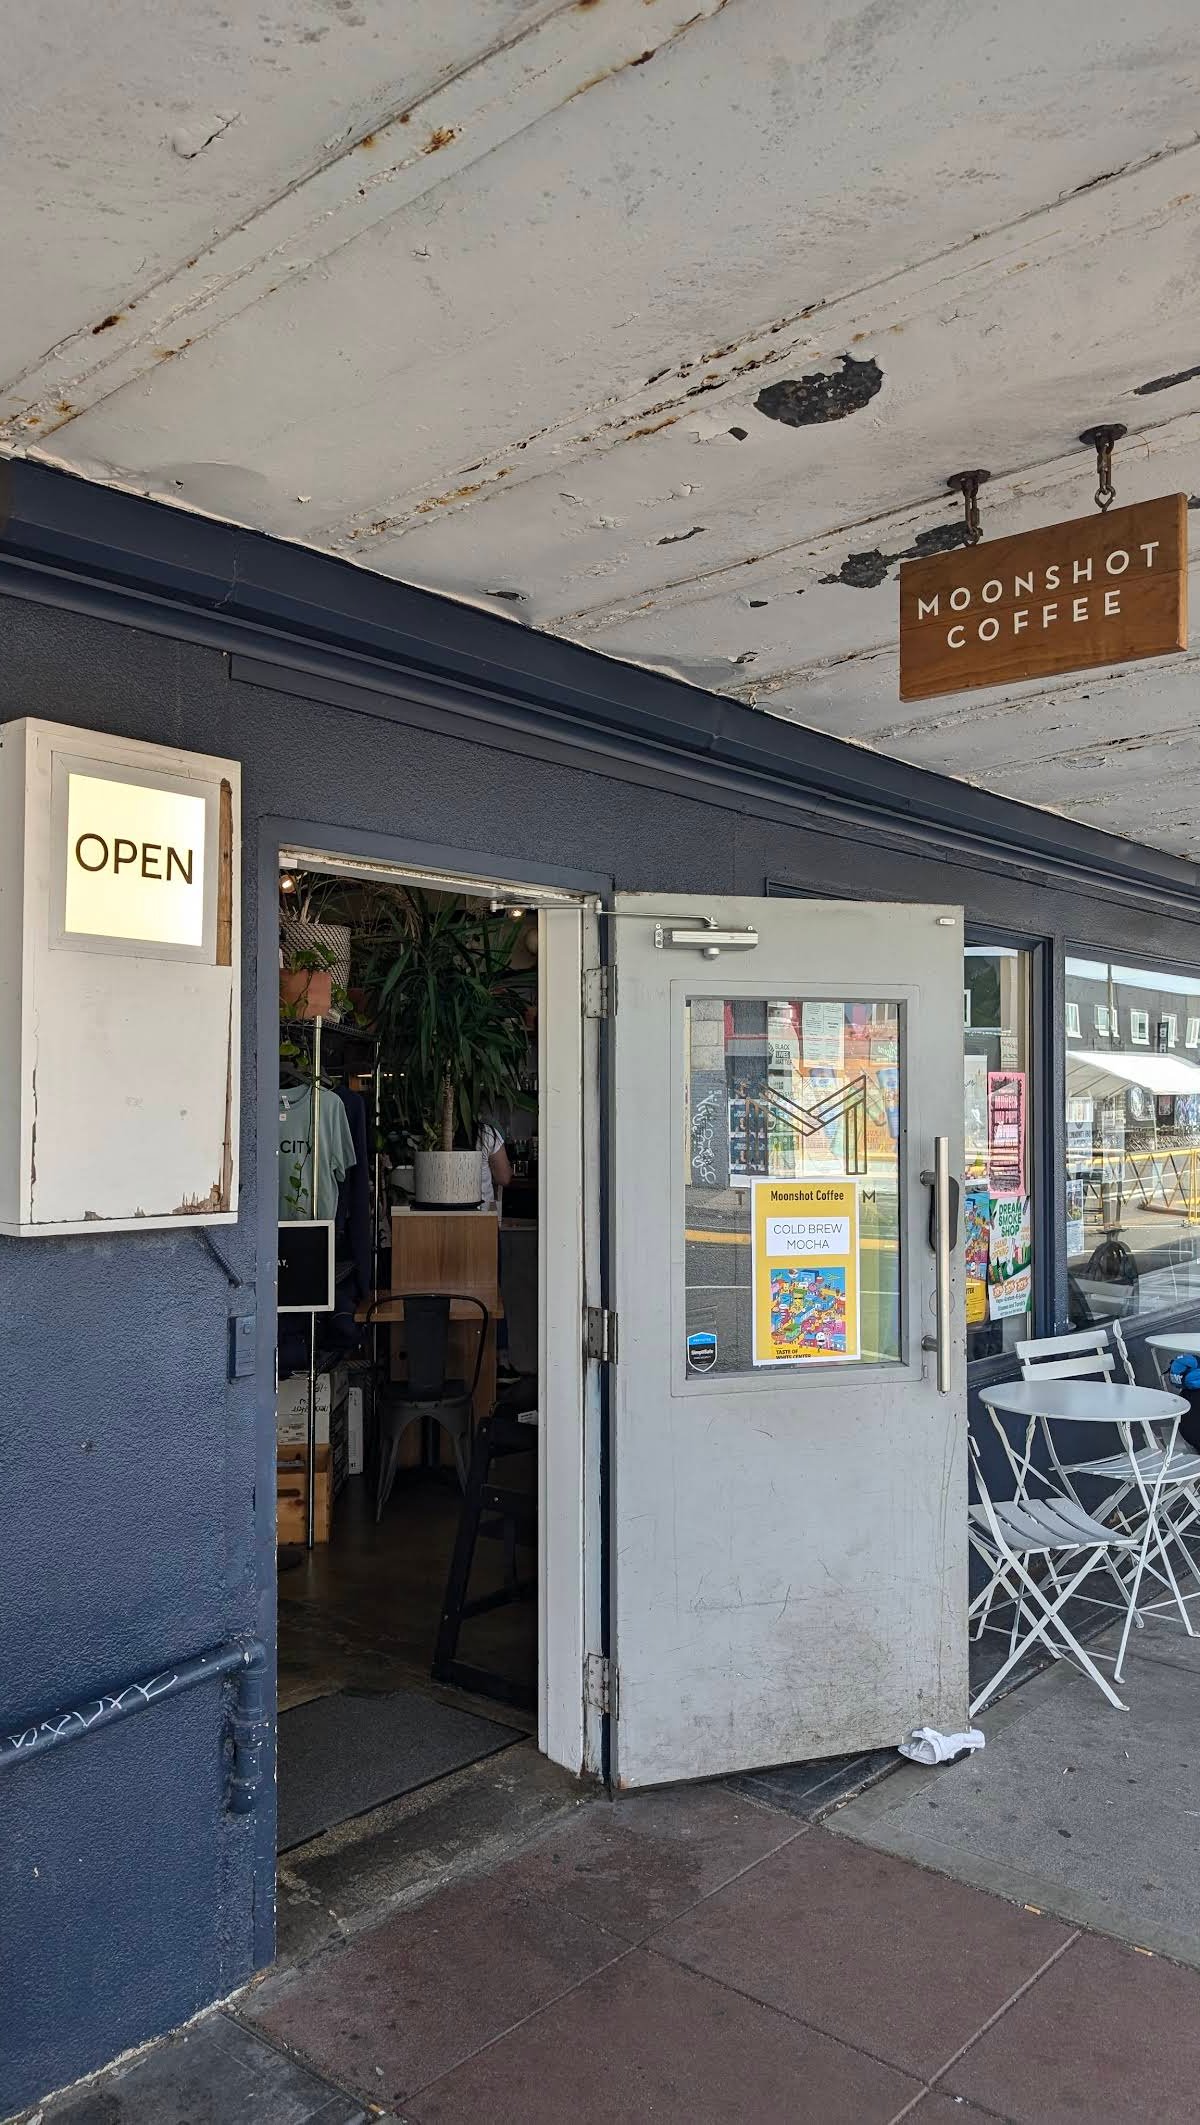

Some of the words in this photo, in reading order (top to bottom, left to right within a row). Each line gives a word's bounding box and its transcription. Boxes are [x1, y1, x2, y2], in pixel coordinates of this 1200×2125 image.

[917, 541, 1160, 621] MOONSHOT
[947, 589, 1121, 649] COFFEE
[75, 832, 193, 885] OPEN
[770, 1190, 814, 1201] Moonshot
[816, 1189, 844, 1201] Coffee
[999, 1201, 1022, 1215] DREAM
[998, 1213, 1022, 1227] SMOKE
[773, 1224, 805, 1235] COLD
[808, 1223, 843, 1234] BREW
[1001, 1225, 1020, 1238] SHOP
[787, 1239, 830, 1250] MOCHA
